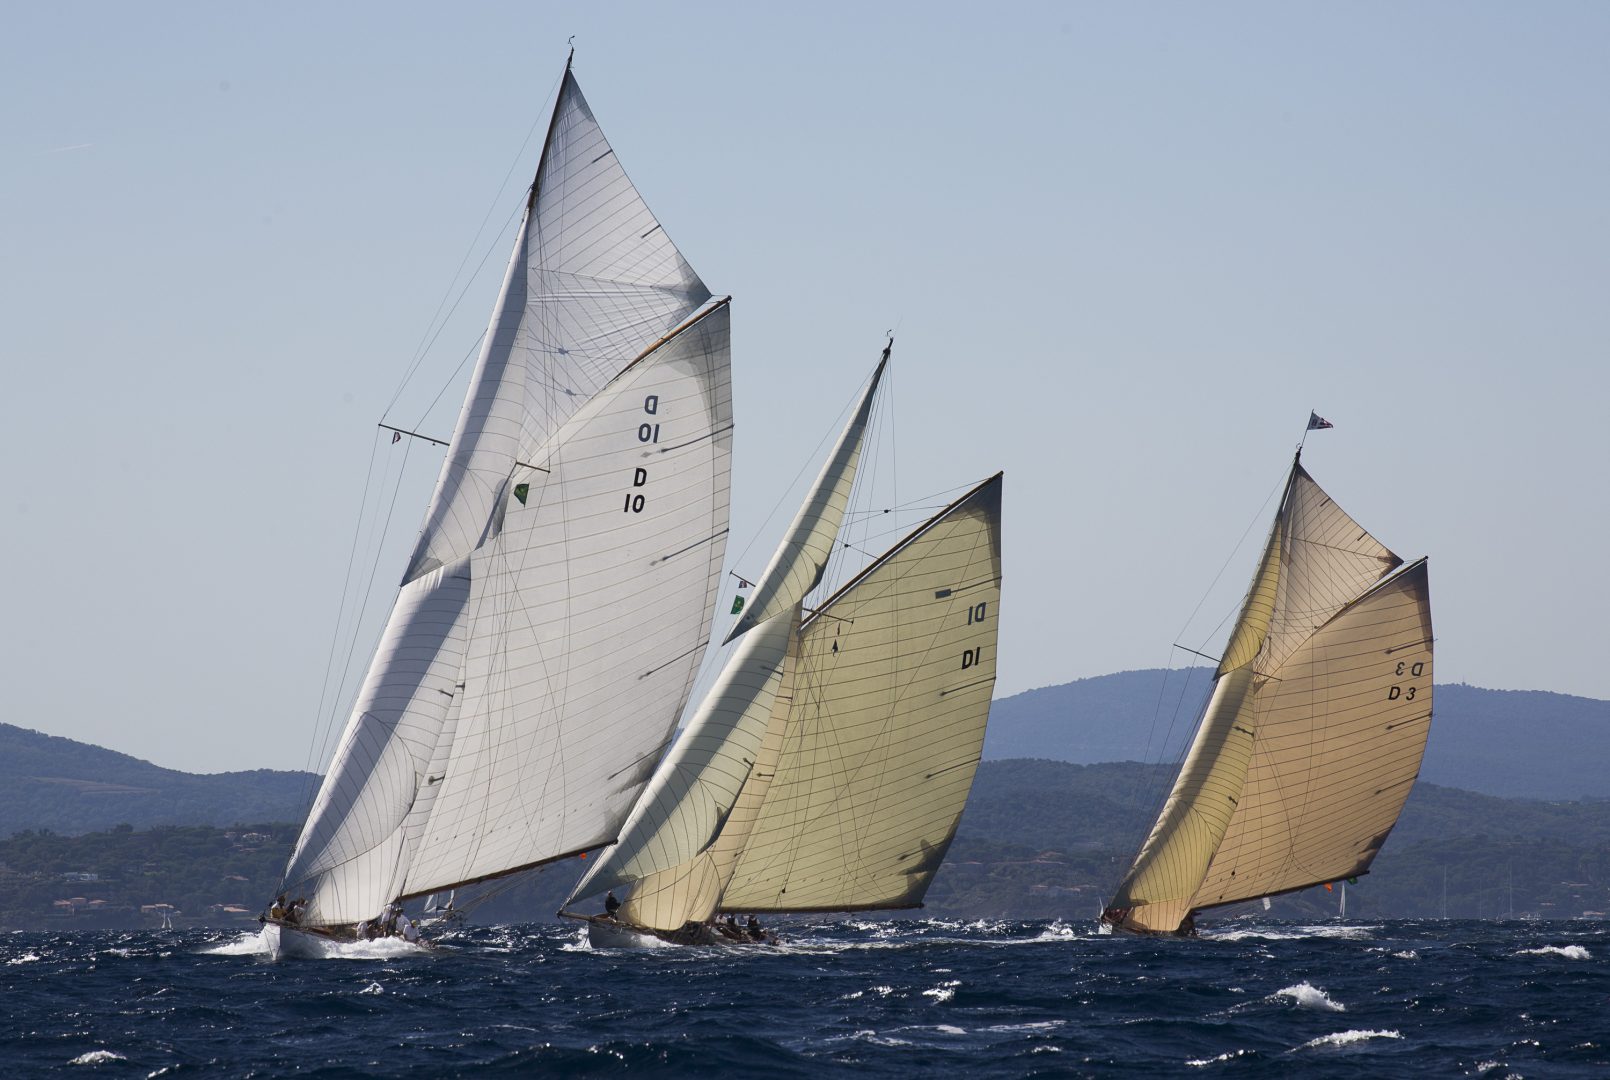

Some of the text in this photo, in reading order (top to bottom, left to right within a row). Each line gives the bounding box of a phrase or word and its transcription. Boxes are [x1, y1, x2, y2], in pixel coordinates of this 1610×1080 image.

[633, 467, 647, 487] D
[624, 493, 645, 514] 10
[961, 646, 980, 670] D1
[1388, 686, 1416, 701] D 3
